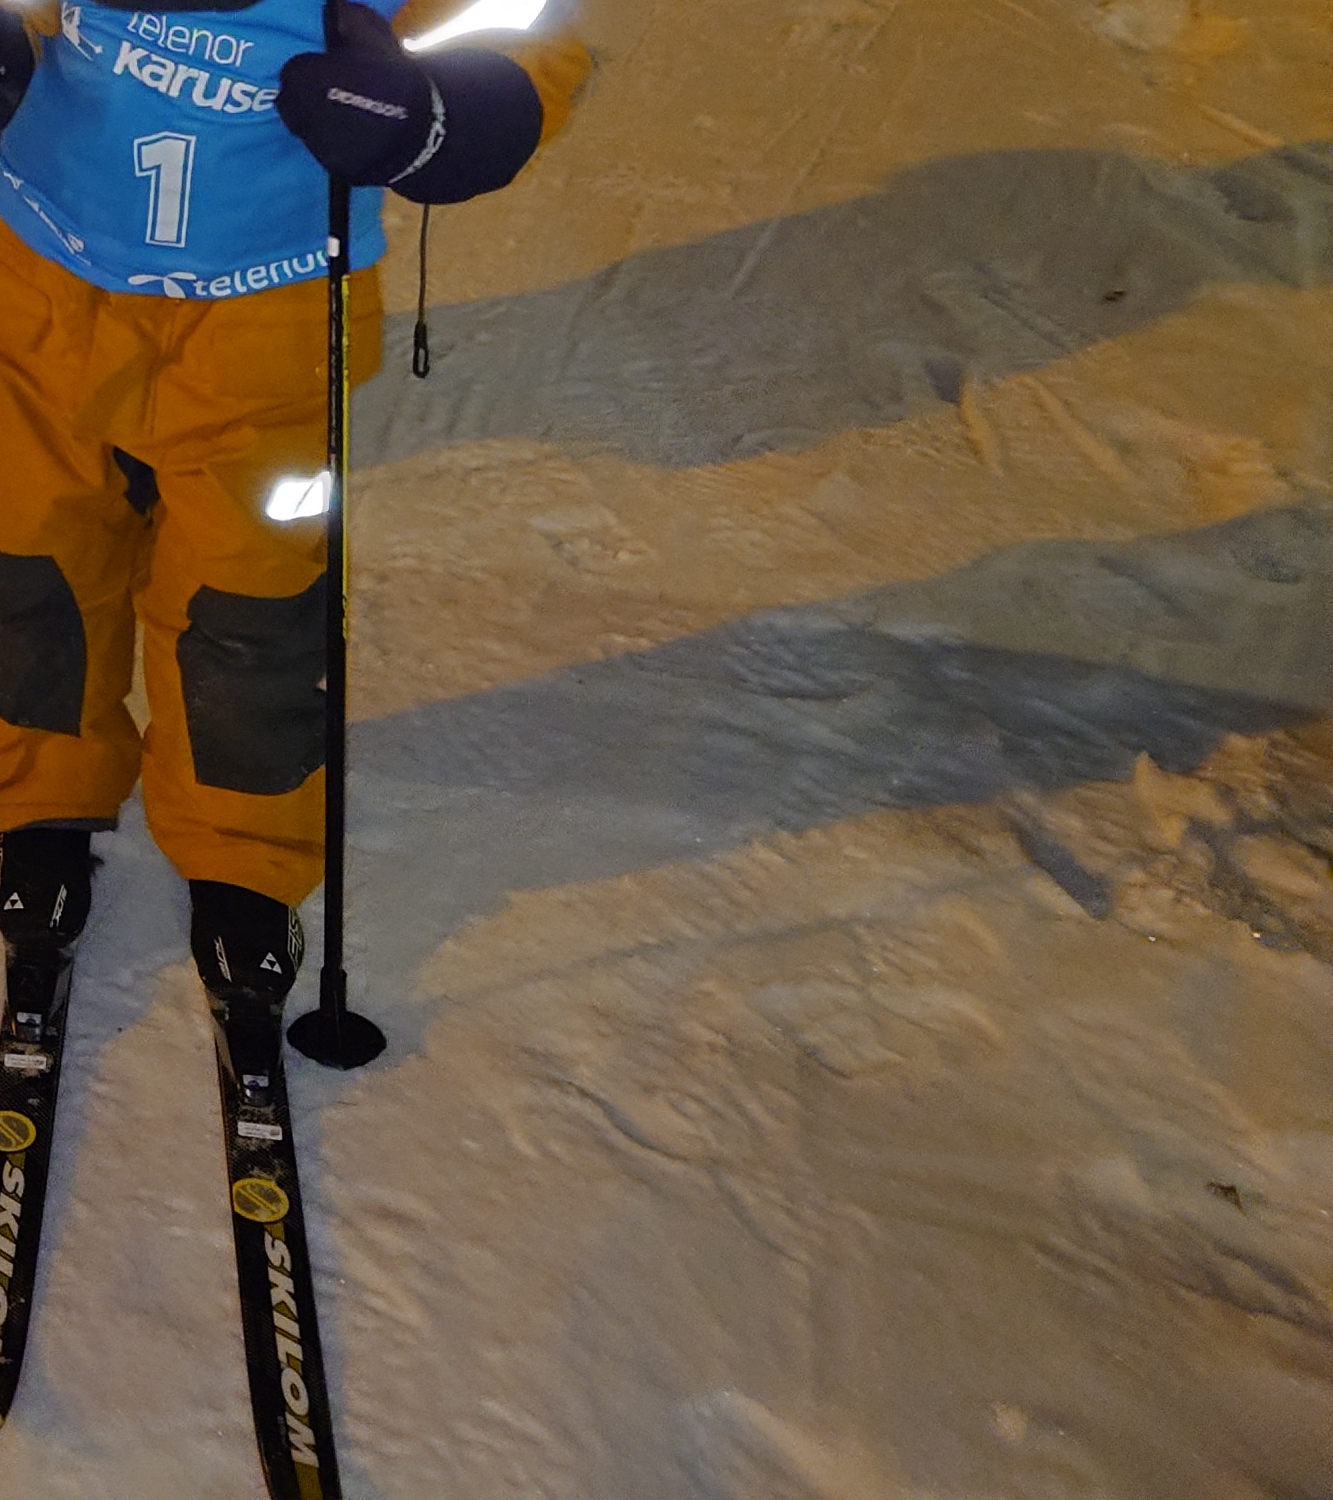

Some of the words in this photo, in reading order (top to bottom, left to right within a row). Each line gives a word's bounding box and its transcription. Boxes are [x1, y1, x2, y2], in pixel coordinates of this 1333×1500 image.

[112, 39, 281, 114] karuse
[127, 11, 254, 67] telenor
[133, 130, 197, 248] 1
[264, 1235, 320, 1468] SKILOM
